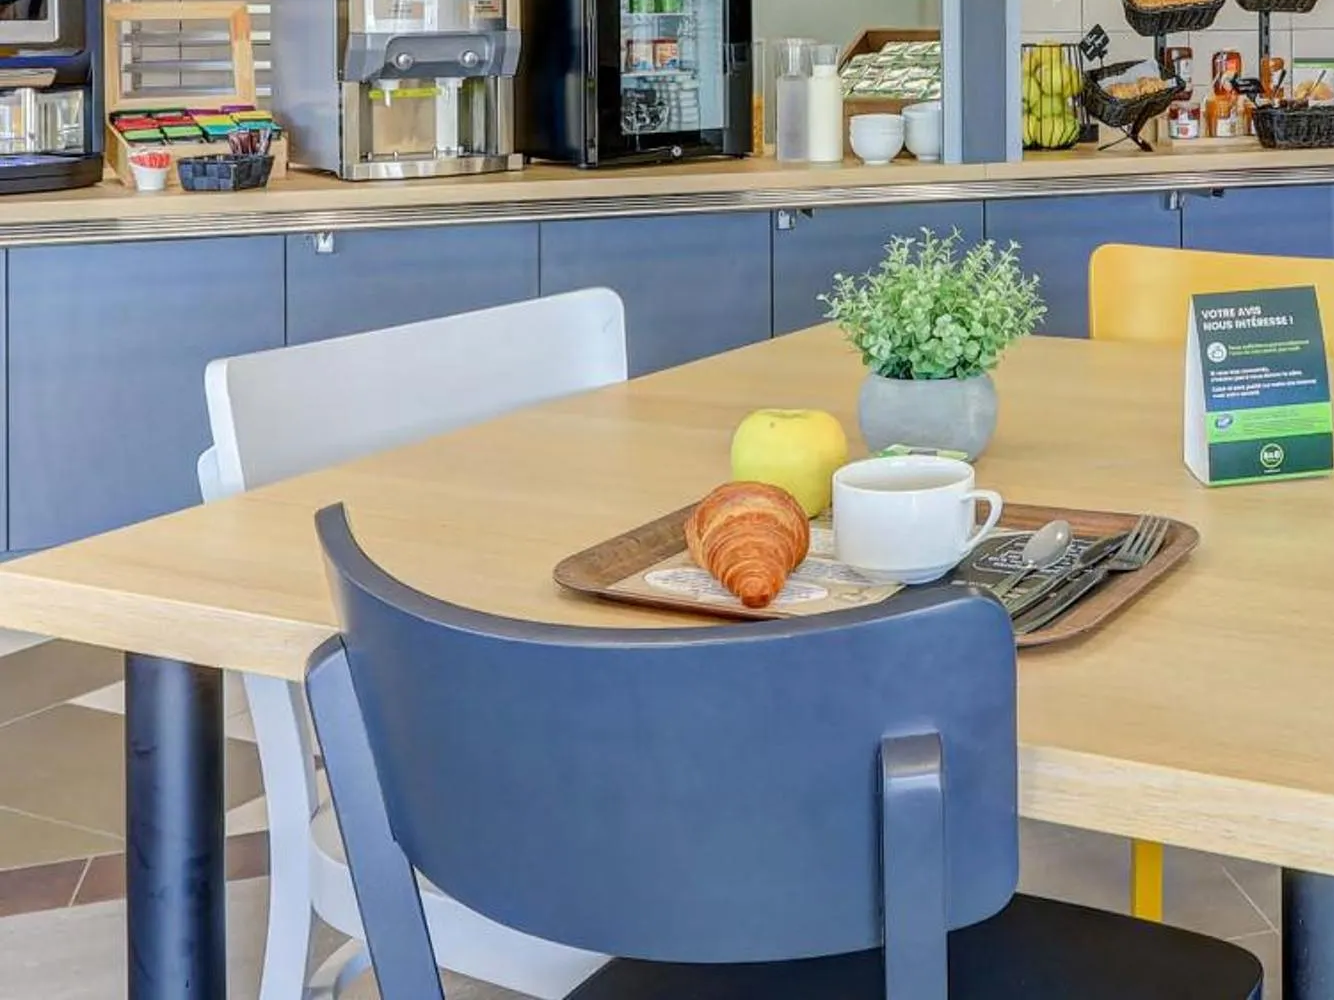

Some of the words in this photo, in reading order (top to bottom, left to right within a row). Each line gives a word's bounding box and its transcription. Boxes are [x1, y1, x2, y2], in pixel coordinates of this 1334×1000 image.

[1201, 306, 1236, 320] VOTRE
[1238, 305, 1262, 317] AVIS
[1203, 319, 1233, 332] NOUS
